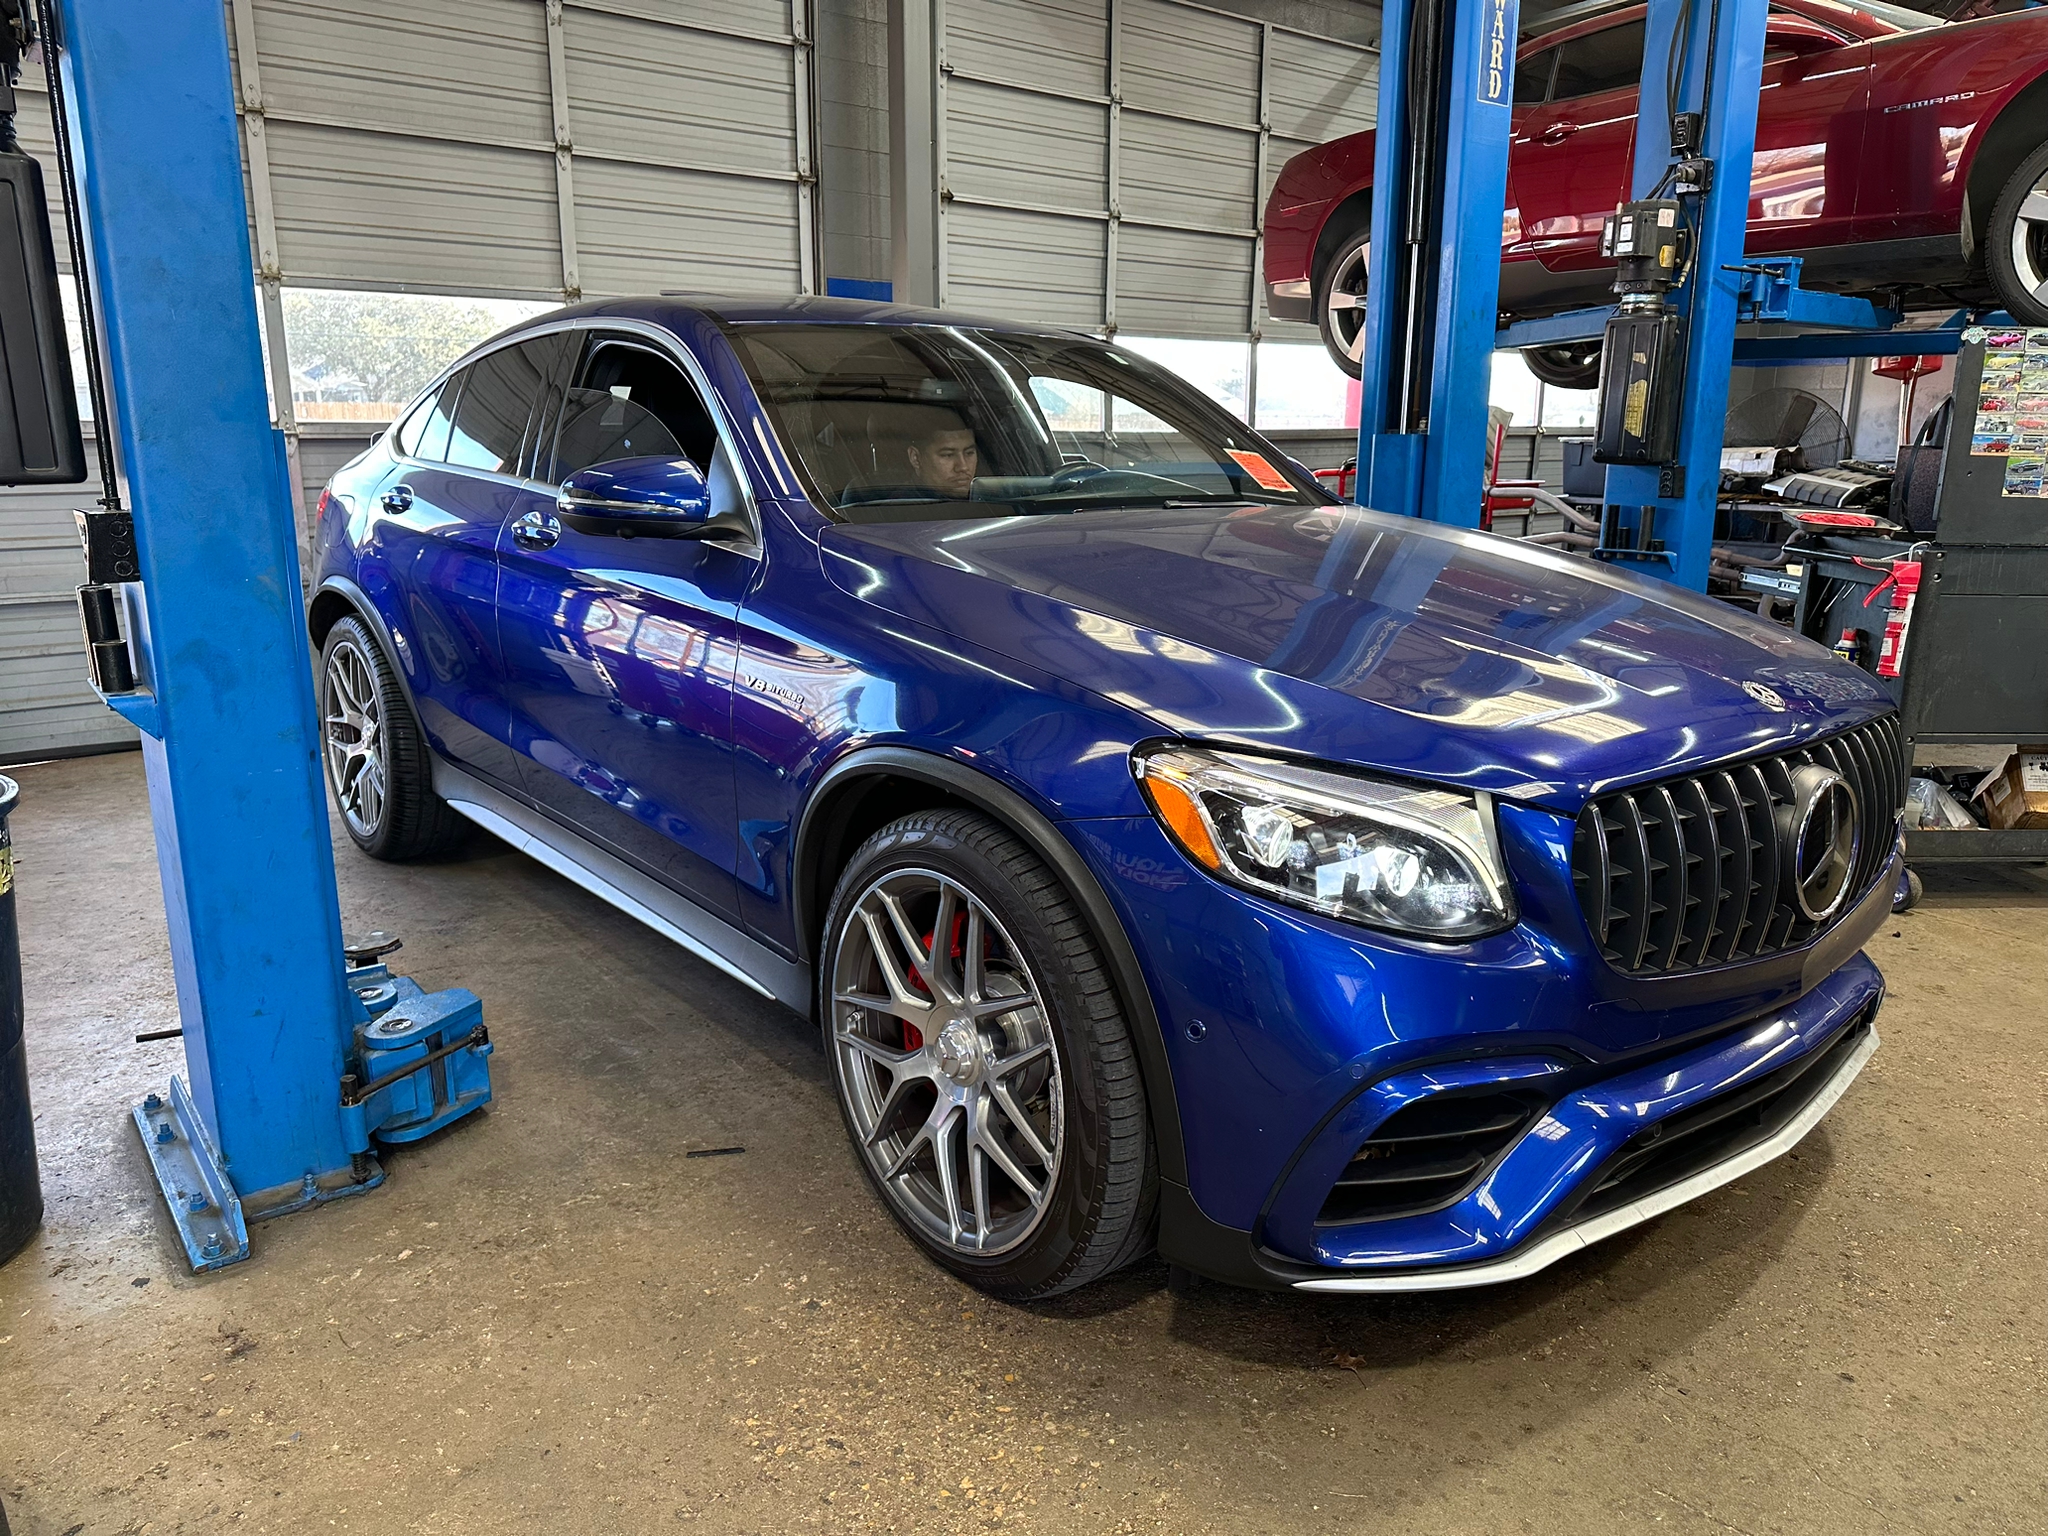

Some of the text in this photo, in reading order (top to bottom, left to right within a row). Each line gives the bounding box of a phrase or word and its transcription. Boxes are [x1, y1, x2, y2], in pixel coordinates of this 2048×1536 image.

[1884, 91, 1975, 114] CAMARO
[744, 674, 805, 704] V8 BITURBO
